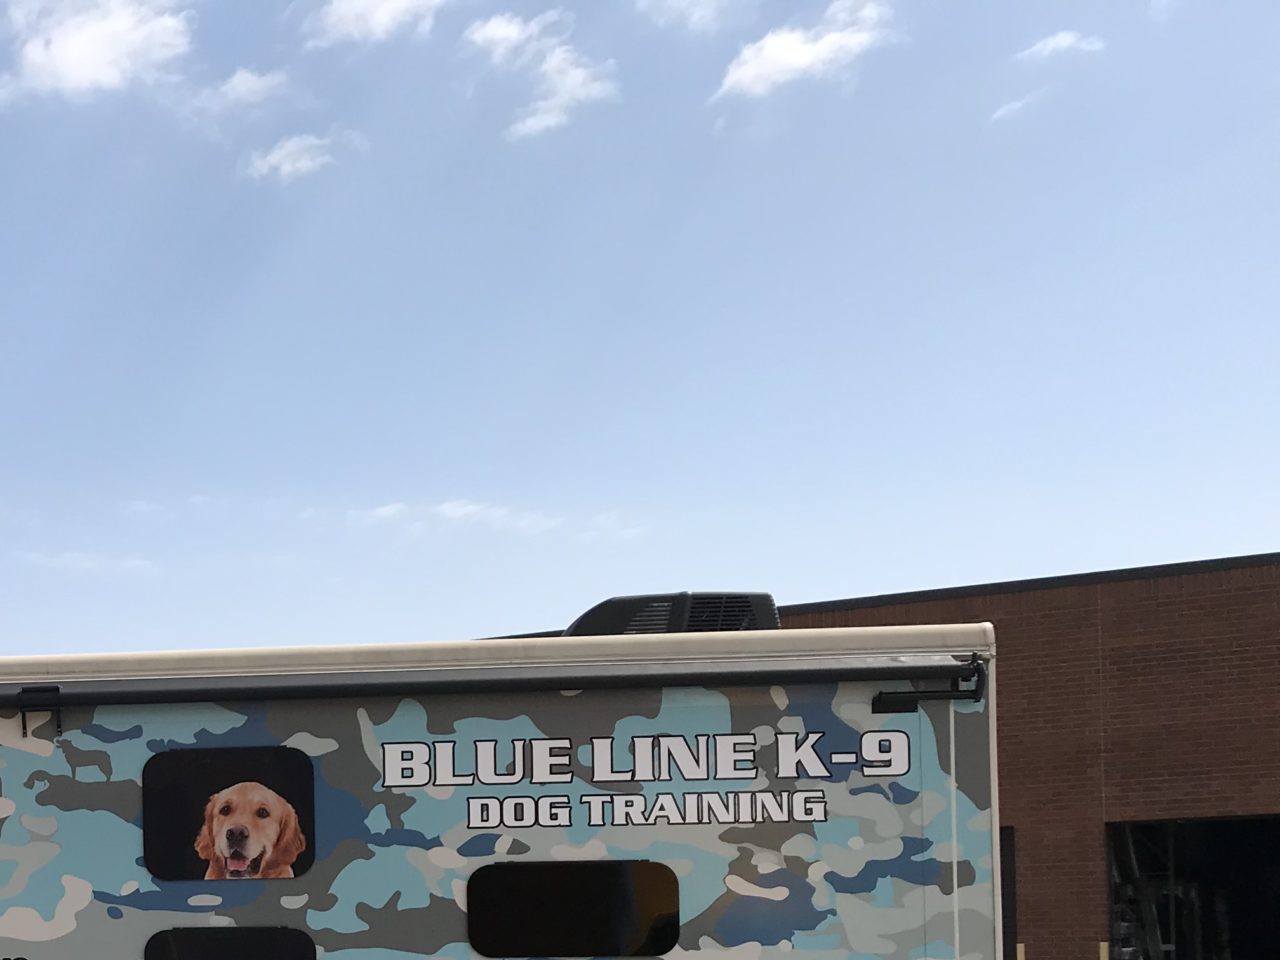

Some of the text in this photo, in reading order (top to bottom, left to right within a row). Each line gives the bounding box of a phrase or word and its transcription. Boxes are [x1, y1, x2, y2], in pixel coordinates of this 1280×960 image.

[382, 730, 911, 787] BLUE LINE K-9
[467, 790, 827, 829] DOG TRAINING
